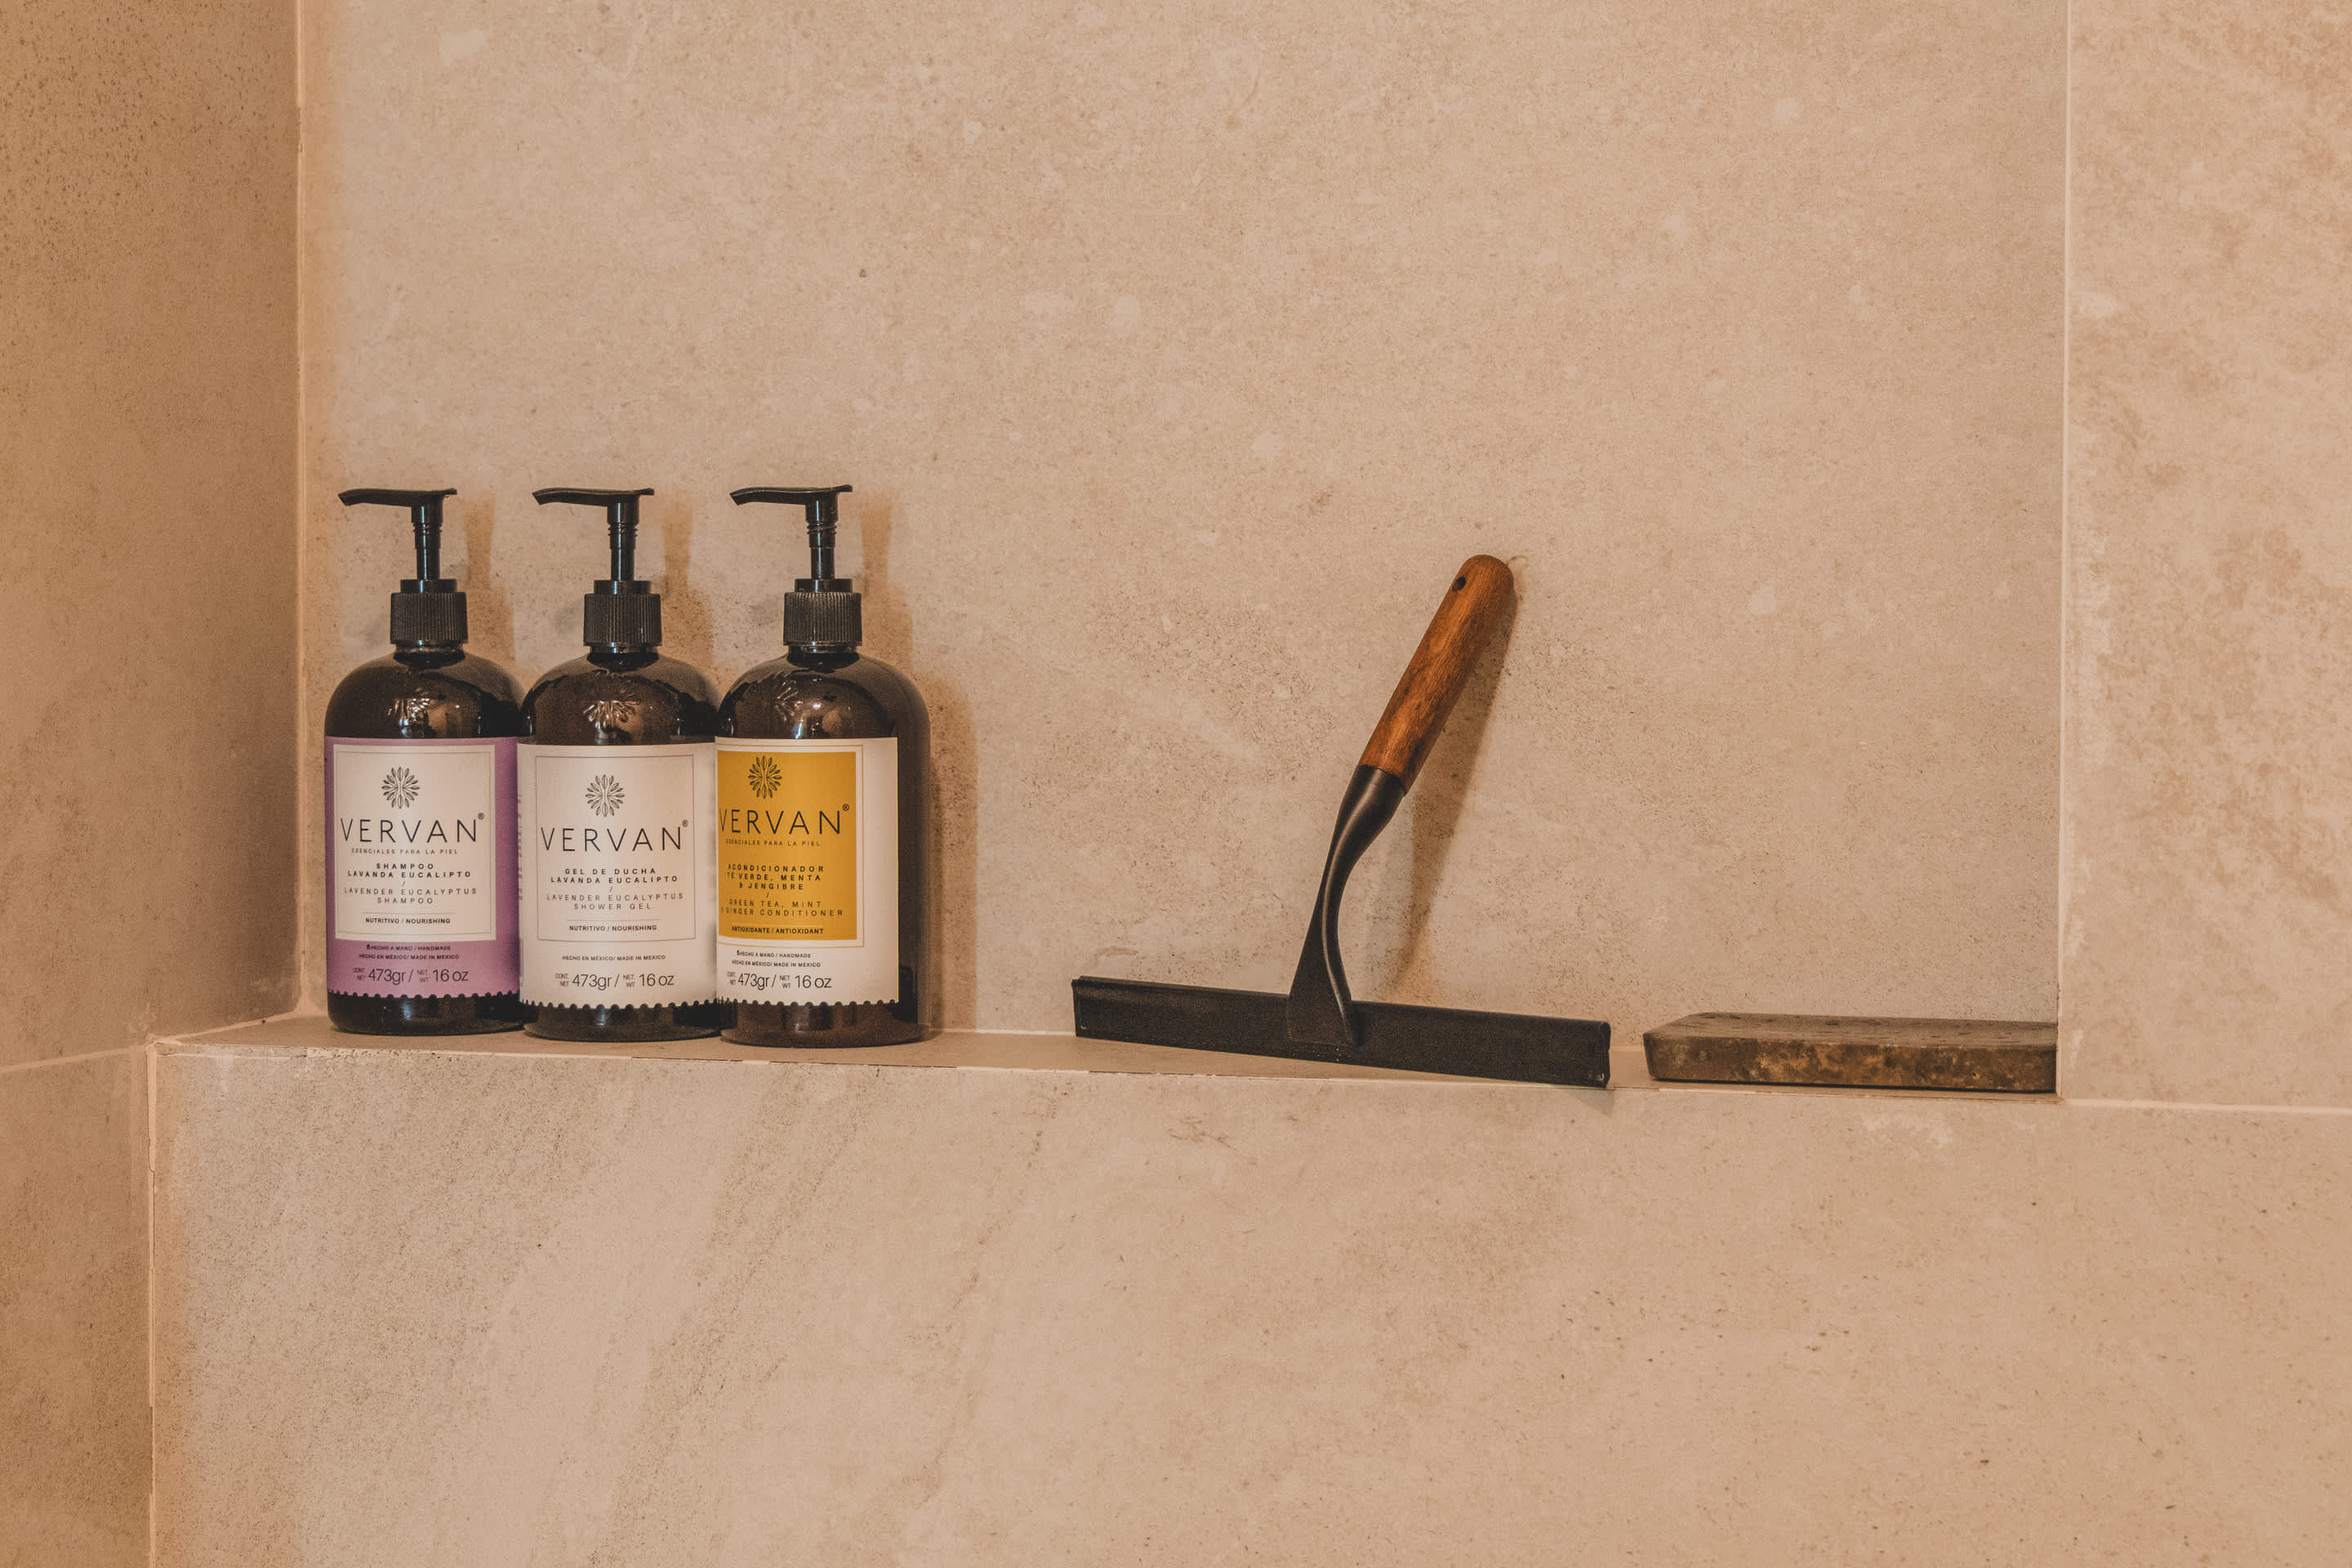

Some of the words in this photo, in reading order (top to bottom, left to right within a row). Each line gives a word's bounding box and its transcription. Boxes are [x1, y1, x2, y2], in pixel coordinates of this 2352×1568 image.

[728, 863, 824, 872] ACONDICIONADOR
[401, 871, 471, 879] EUCALIPTO
[738, 873, 773, 881] VERDE,
[608, 875, 678, 884] EUCALIPTO
[344, 887, 394, 895] LAVENDER
[608, 893, 684, 901] EUCALYPTUS
[732, 925, 770, 933] ANTIOXIDANTE
[368, 968, 407, 986] 473gr
[433, 969, 450, 982] 16
[452, 970, 469, 982] oz
[572, 973, 612, 991] 473gr
[639, 973, 656, 987] 16
[658, 975, 675, 987] oz
[737, 973, 770, 991] 473gr
[795, 974, 812, 988] 16
[814, 977, 832, 988] oz
